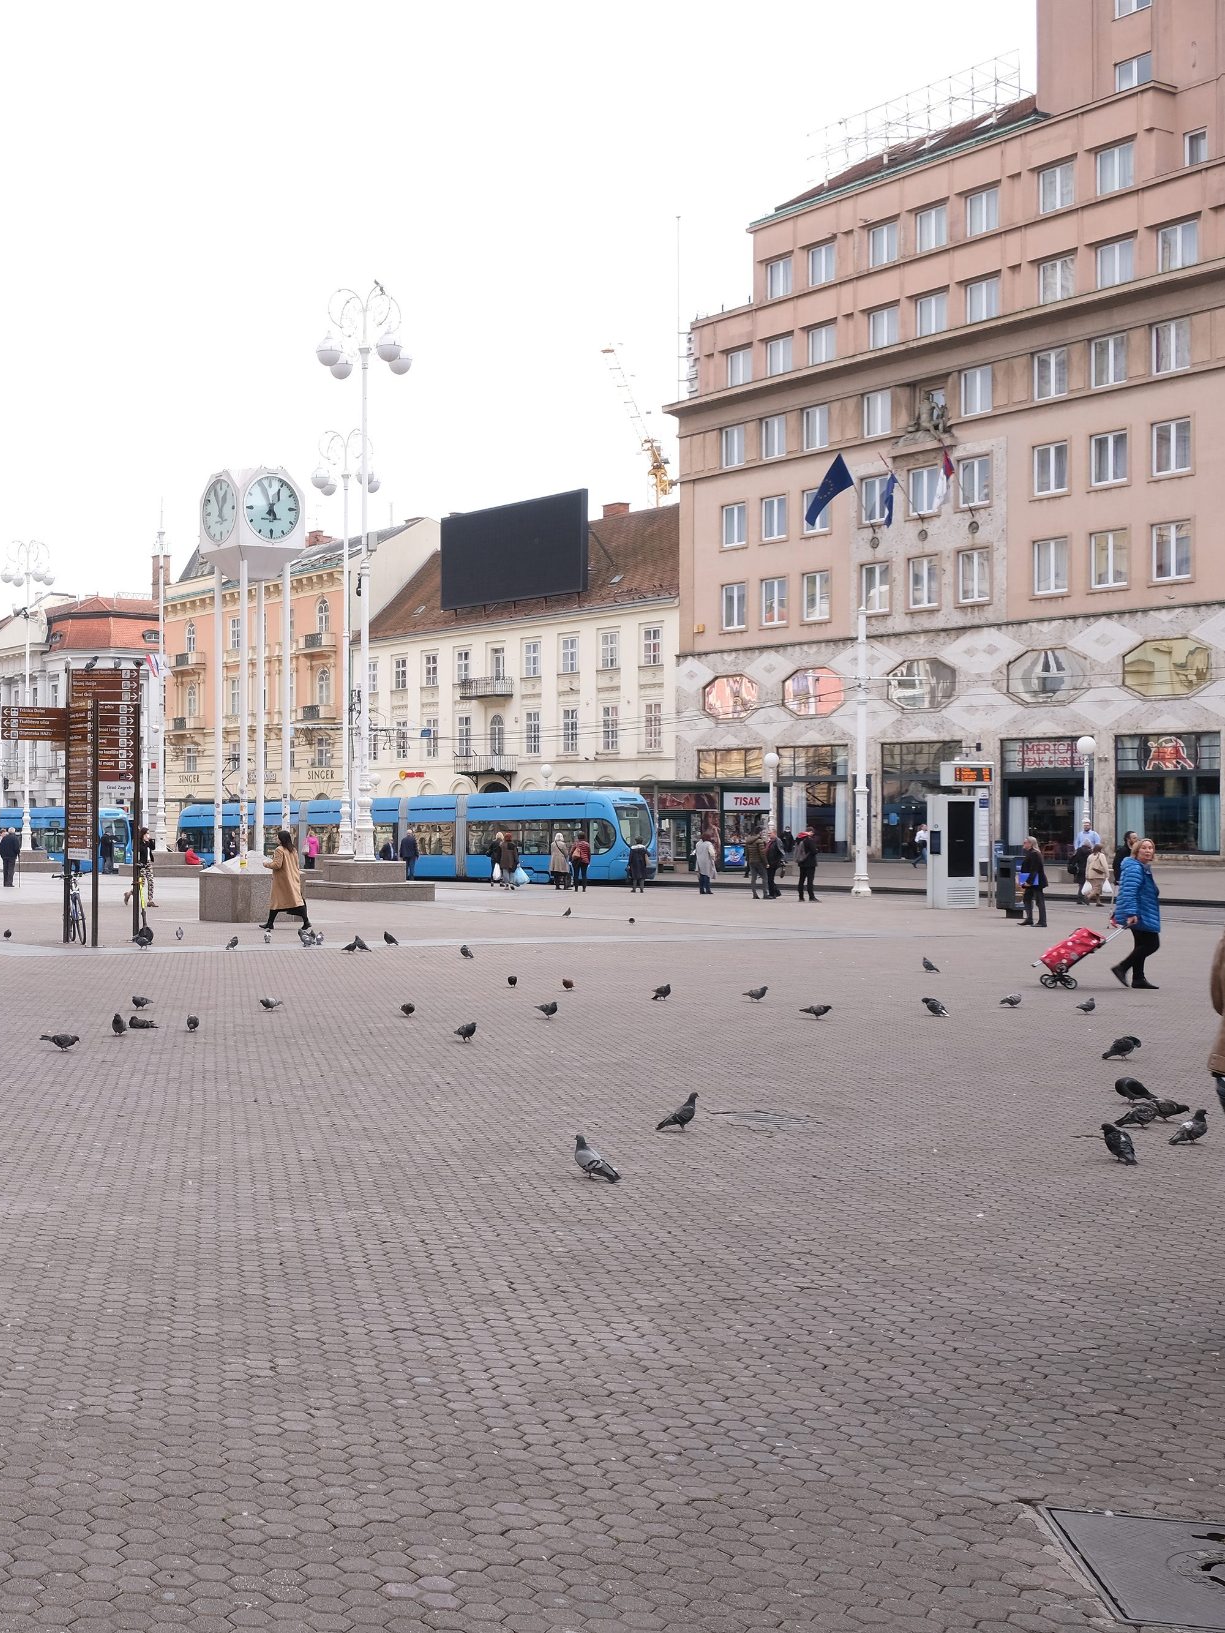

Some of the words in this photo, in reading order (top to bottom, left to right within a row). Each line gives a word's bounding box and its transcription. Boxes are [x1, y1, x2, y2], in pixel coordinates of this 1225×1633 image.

[1017, 742, 1078, 755] AMERICA
[178, 774, 200, 783] SINGER
[307, 769, 335, 780] SINGER
[733, 796, 761, 806] TISAK
